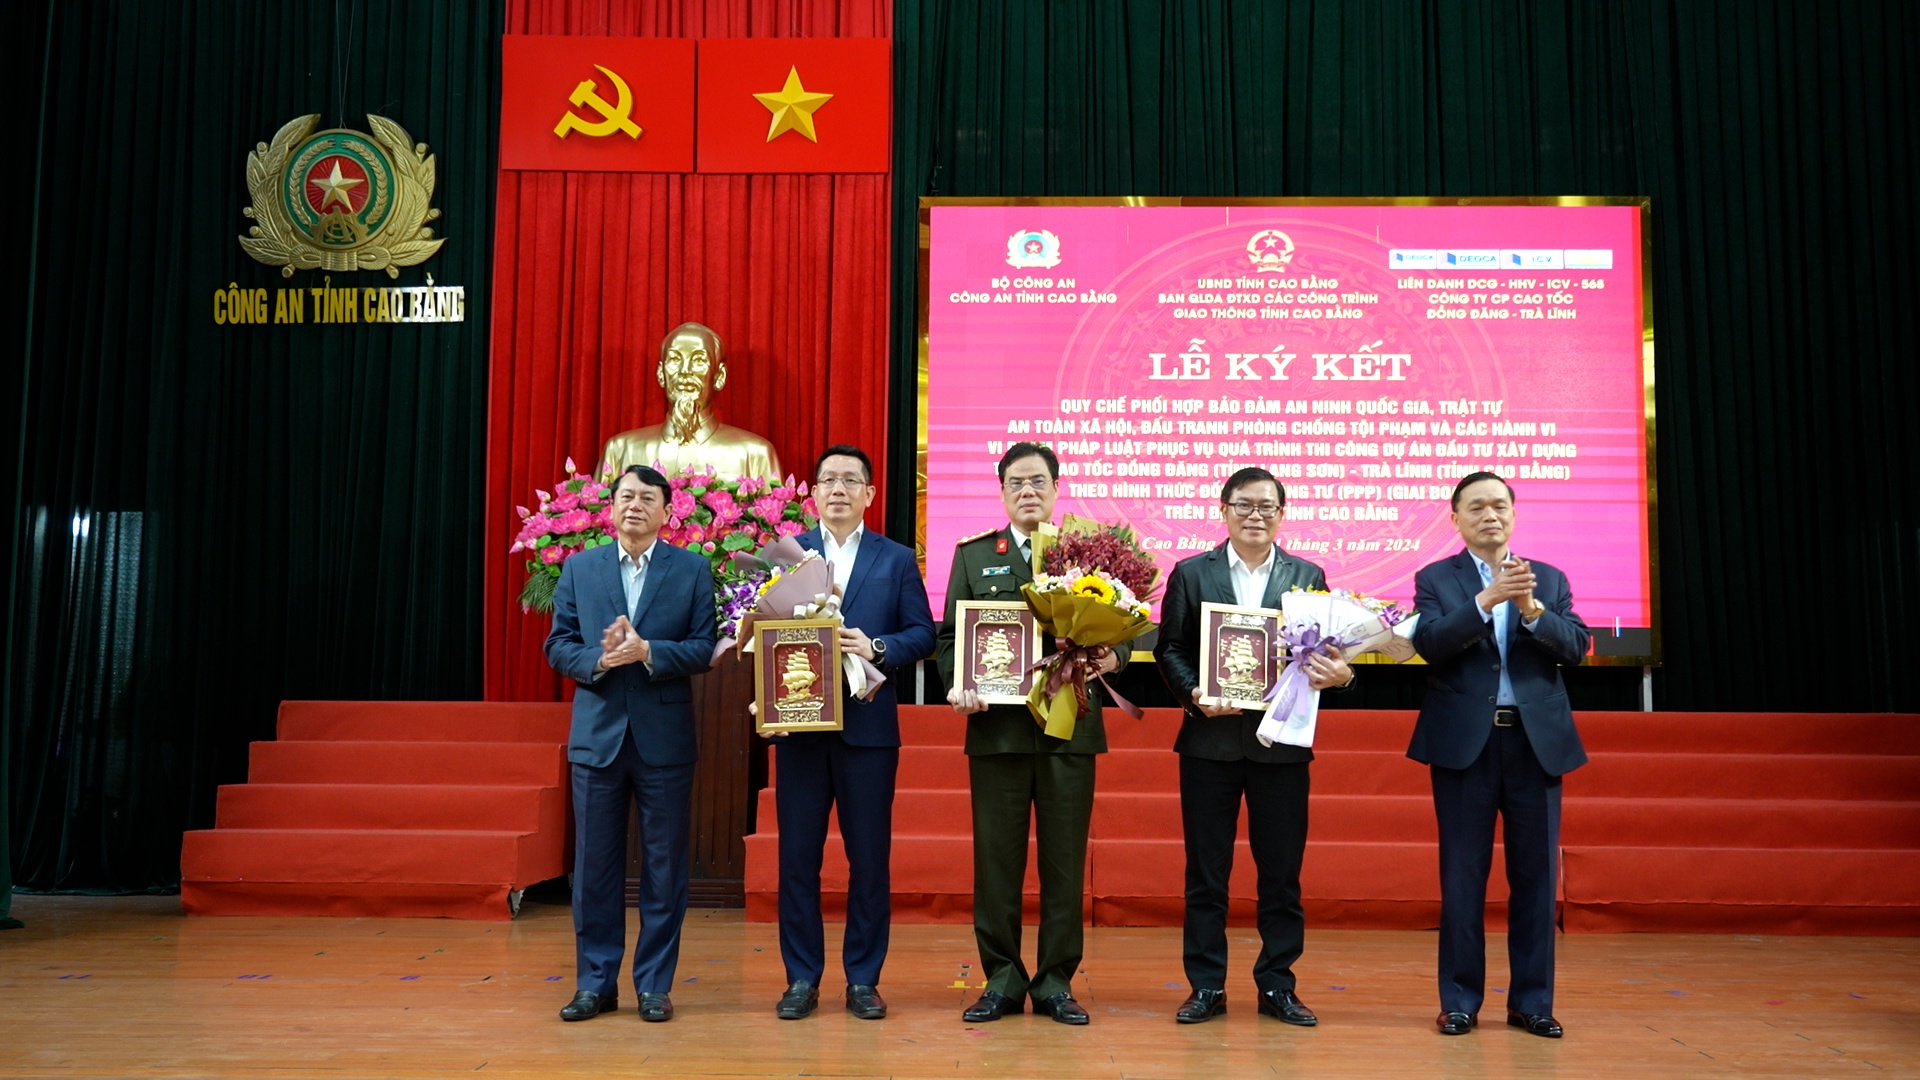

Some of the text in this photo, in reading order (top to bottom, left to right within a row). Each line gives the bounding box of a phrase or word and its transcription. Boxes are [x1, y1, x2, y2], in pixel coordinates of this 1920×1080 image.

[992, 275, 1076, 290] BỘ CÔNG AN
[1198, 274, 1338, 288] UBND TỈNH CAO BẰNG
[1398, 276, 1424, 288] LIÊN
[1426, 278, 1464, 288] DANH
[1468, 278, 1498, 288] DCG
[1508, 278, 1536, 288] HHV
[1548, 278, 1570, 288] ICV
[1582, 278, 1604, 288] 568
[214, 272, 465, 325] CÔNG AN TỈNH CAO BẰNG
[950, 288, 1118, 303] CÔNG AN TỈNH CAO BẰNG
[1158, 290, 1378, 304] BAN QLDA ĐTXD CÁC CÔNG TRÌNH
[1428, 290, 1574, 304] CÔNG TY CP CAO TỐC
[1174, 304, 1364, 318] GIAO THÔNG TỈNH CAO BẰNG
[1426, 305, 1466, 319] ĐỒNG
[1470, 306, 1510, 319] ĐĂNG
[1520, 306, 1544, 319] TRÀ
[1548, 306, 1576, 319] LĨNH
[1148, 338, 1412, 381] LỄ KÝ KẾT
[1060, 395, 1504, 417] QUY CHẾ PHỐI HỢP BẢO ĐẢM AN NINH QUỐC GIA, TRẬT TỰ
[1008, 417, 1556, 438] AN TOÀN XÃ HỘI, ĐẤU TRANH PHÒNG CHỐNG TỘI PHẠM VÀ CÁC HÀNH VI
[988, 441, 1002, 454] VI
[1058, 439, 1100, 455] PHÁP
[1104, 439, 1142, 458] LUẬT
[1146, 442, 1188, 458] PHỤC
[1194, 442, 1214, 458] VỤ
[1218, 439, 1250, 455] QUÁ
[1256, 440, 1302, 456] TRÌNH
[1306, 443, 1330, 456] THI
[1334, 440, 1378, 456] CÔNG
[1382, 443, 1406, 459] DỰ
[1408, 440, 1432, 456] ÁN
[1434, 439, 1468, 457] ĐẦU
[1472, 444, 1494, 457] TƯ
[1496, 441, 1528, 457] XÂY
[1532, 444, 1576, 460] DỰNG
[1058, 462, 1080, 476] AO
[1084, 458, 1114, 476] TỐC
[1164, 460, 1208, 476] ĐĂNG
[1306, 464, 1346, 478] SƠN)
[1360, 461, 1392, 477] TRÀ
[1394, 461, 1432, 477] LĨNH
[1436, 461, 1480, 479] (TỈNH
[1520, 460, 1570, 480] BẰNG)
[1070, 480, 1456, 500] THEO HÌNH THỨC ĐỐ NG TƯ (PPP) (GIAI ĐO
[1164, 503, 1206, 519] TRÊN
[1318, 507, 1350, 520] CAO
[1354, 503, 1398, 520] BẰNG
[1141, 536, 1172, 550] Cao
[1286, 538, 1329, 553] tháng
[1332, 539, 1344, 551] 3
[1347, 538, 1381, 551] năm
[1384, 538, 1421, 551] 2024
